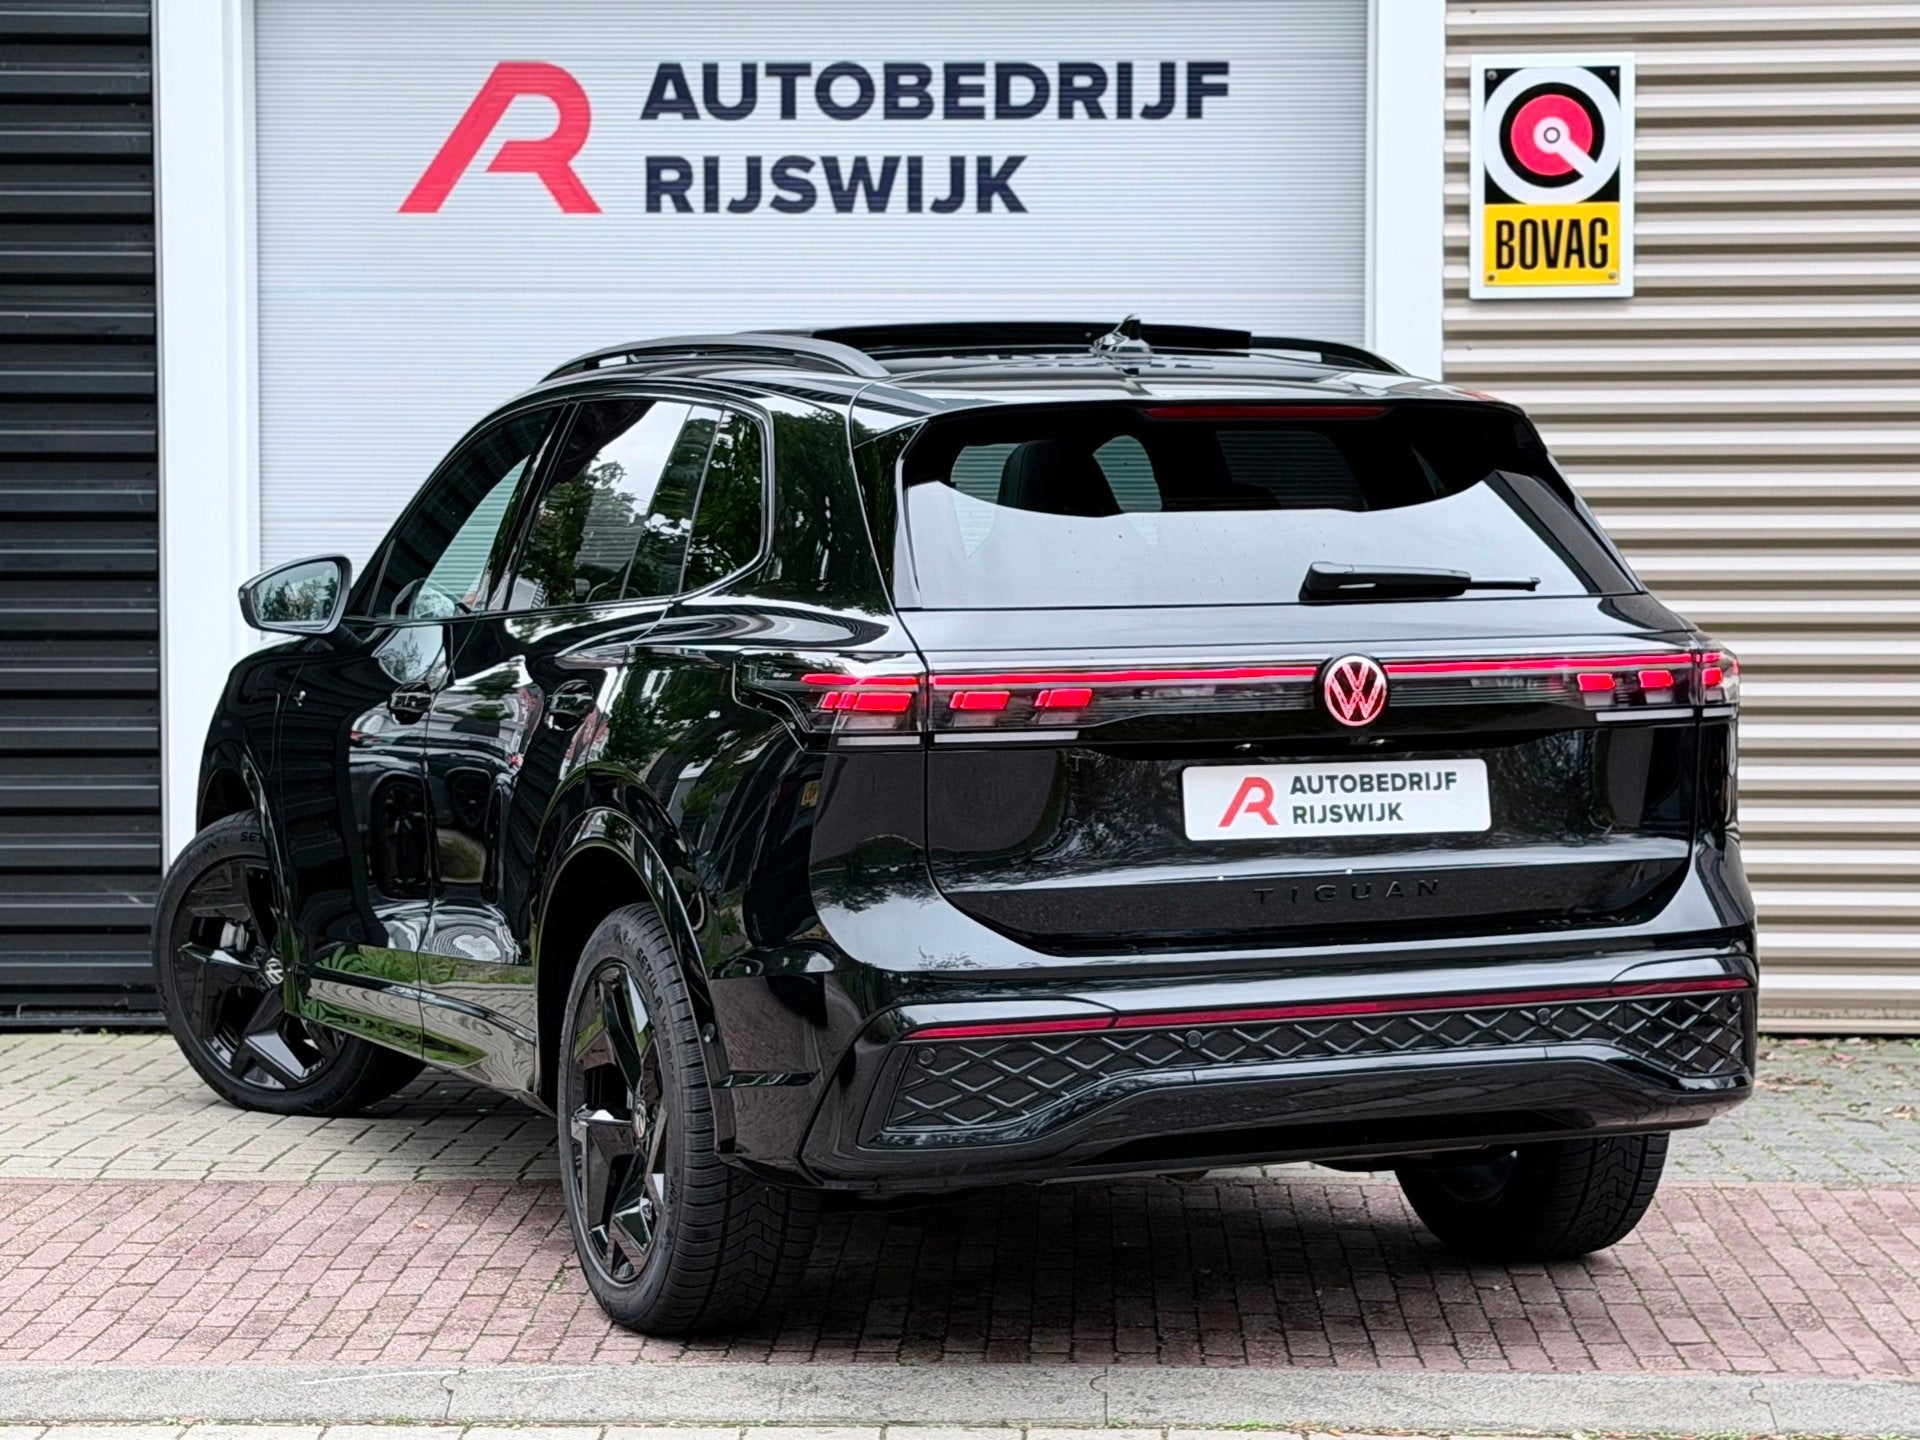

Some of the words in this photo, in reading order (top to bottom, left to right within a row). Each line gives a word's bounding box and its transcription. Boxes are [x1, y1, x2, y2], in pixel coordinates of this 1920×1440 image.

[640, 61, 1230, 121] AUTOBEDRIJF
[645, 155, 1028, 214] RIJSWIJK
[1496, 217, 1609, 270] BOVAG
[1290, 771, 1458, 796] AUTOBEDRIJF
[1292, 802, 1404, 825] RIJSWIJK
[1252, 878, 1440, 905] TIGUAN
